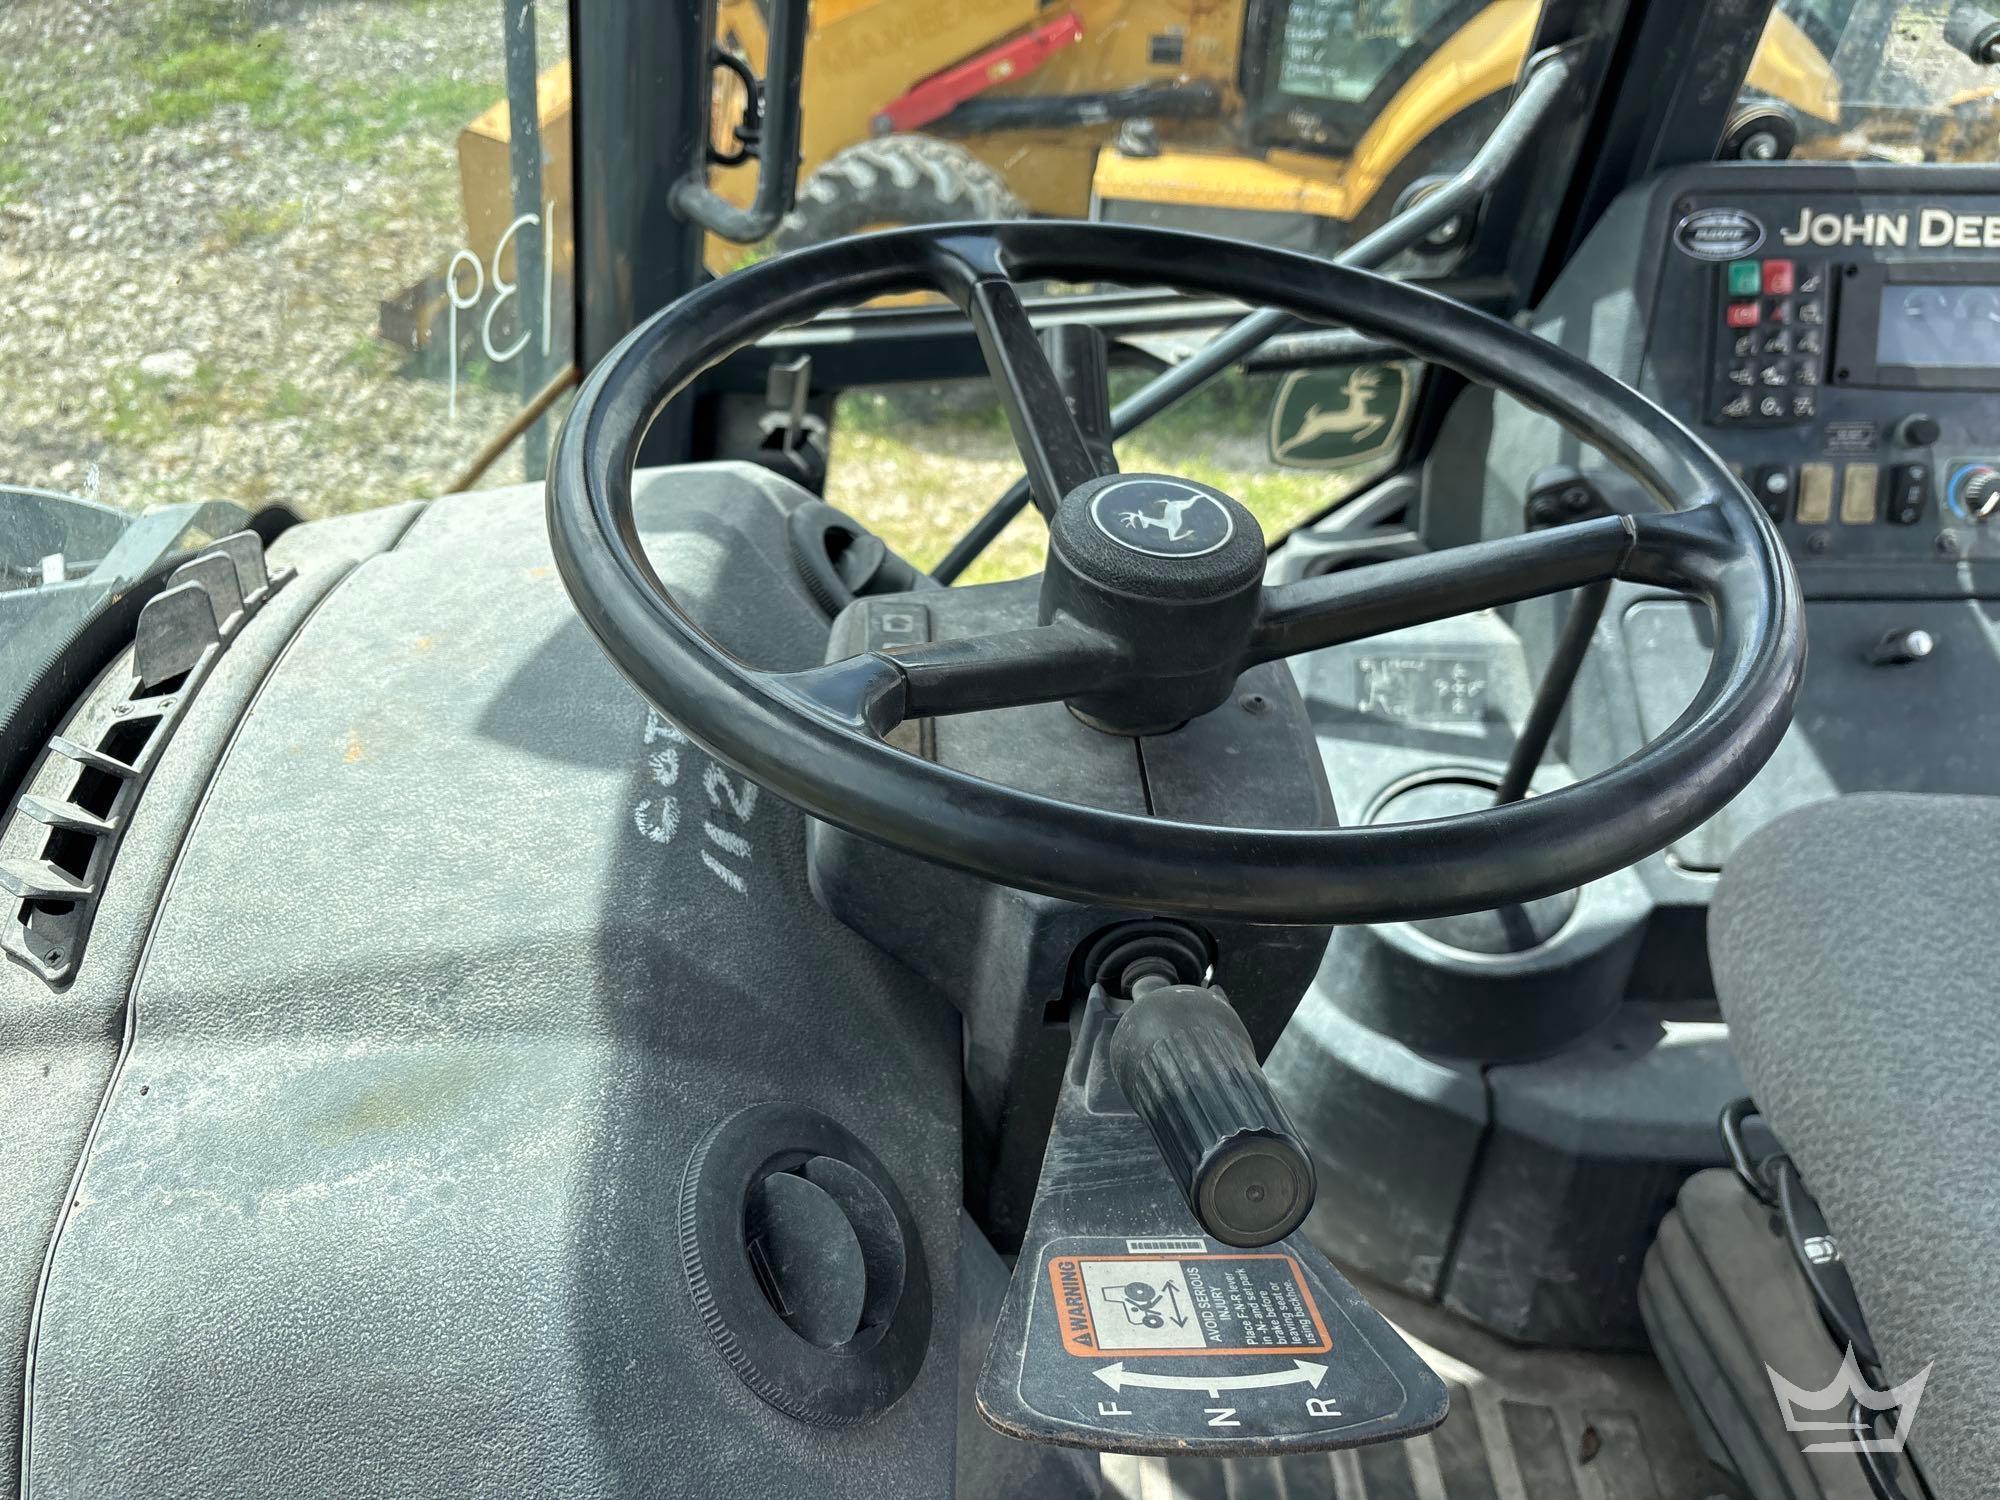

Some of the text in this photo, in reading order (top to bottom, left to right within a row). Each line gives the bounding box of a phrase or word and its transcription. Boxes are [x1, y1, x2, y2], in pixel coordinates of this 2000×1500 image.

[1780, 207, 1909, 246] JOHN
[1235, 1267, 1253, 1286] park
[1058, 1261, 1088, 1331] WARNING
[1187, 1267, 1222, 1342] AVOID SERIOUS
[1209, 1286, 1231, 1320] INJURY
[1225, 1272, 1259, 1345] Place F-N-R lever
[1243, 1287, 1256, 1302] set
[1247, 1302, 1263, 1319] and
[1283, 1279, 1317, 1344] using backhoe.
[1260, 1290, 1288, 1345] brake before
[1270, 1281, 1302, 1344] leaving seat or
[1262, 1336, 1273, 1345] in
[1098, 1401, 1132, 1416] F
[1204, 1408, 1241, 1427] N
[1305, 1397, 1342, 1418] R
